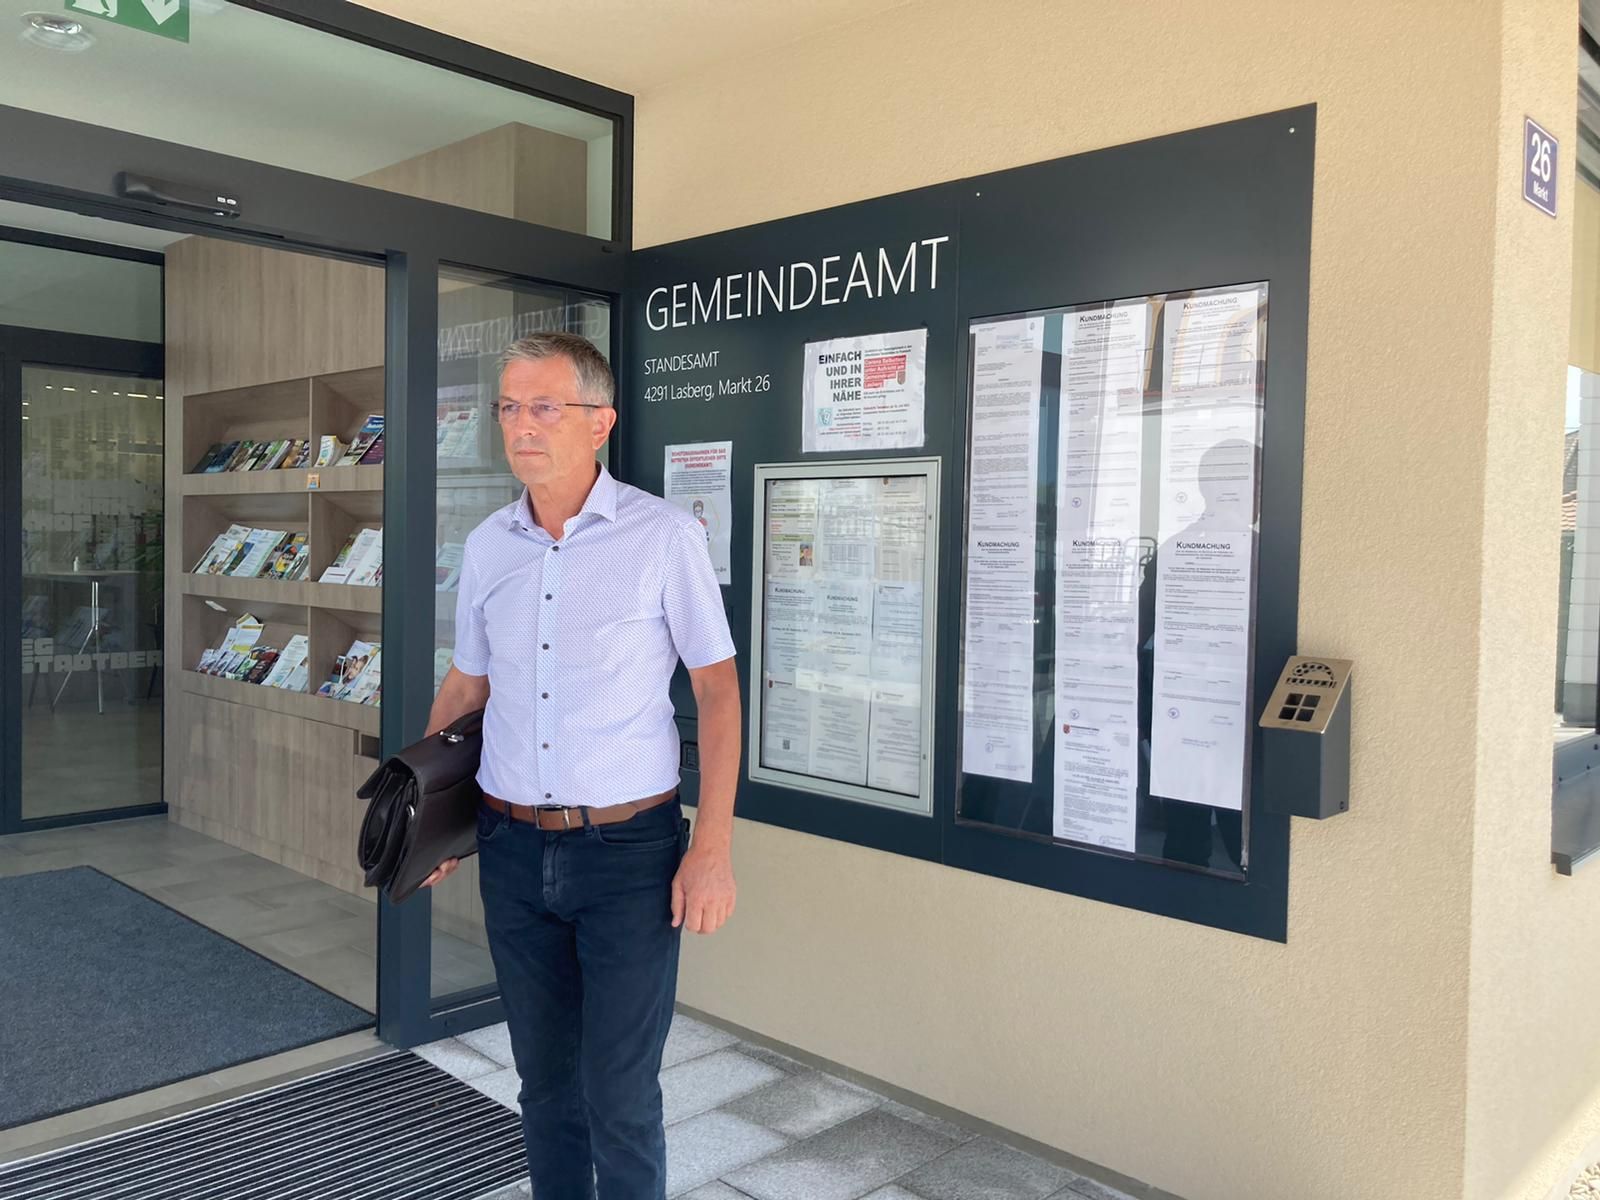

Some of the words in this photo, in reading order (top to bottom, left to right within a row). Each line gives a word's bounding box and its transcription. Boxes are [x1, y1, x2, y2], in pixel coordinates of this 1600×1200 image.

[1531, 132, 1551, 182] 26
[645, 235, 950, 332] GEMEINDEAMT
[644, 350, 720, 375] STANDESAMT
[818, 350, 862, 365] EINFACH
[826, 365, 848, 377] UND
[850, 363, 862, 374] IN
[644, 385, 668, 402] 4291
[671, 382, 715, 402] Lasberg,
[718, 377, 752, 396] Markt
[754, 374, 771, 392] 26
[830, 377, 862, 390] IHRER
[832, 390, 862, 402] NÄHE
[1176, 540, 1231, 550] KUNDMACHUNG
